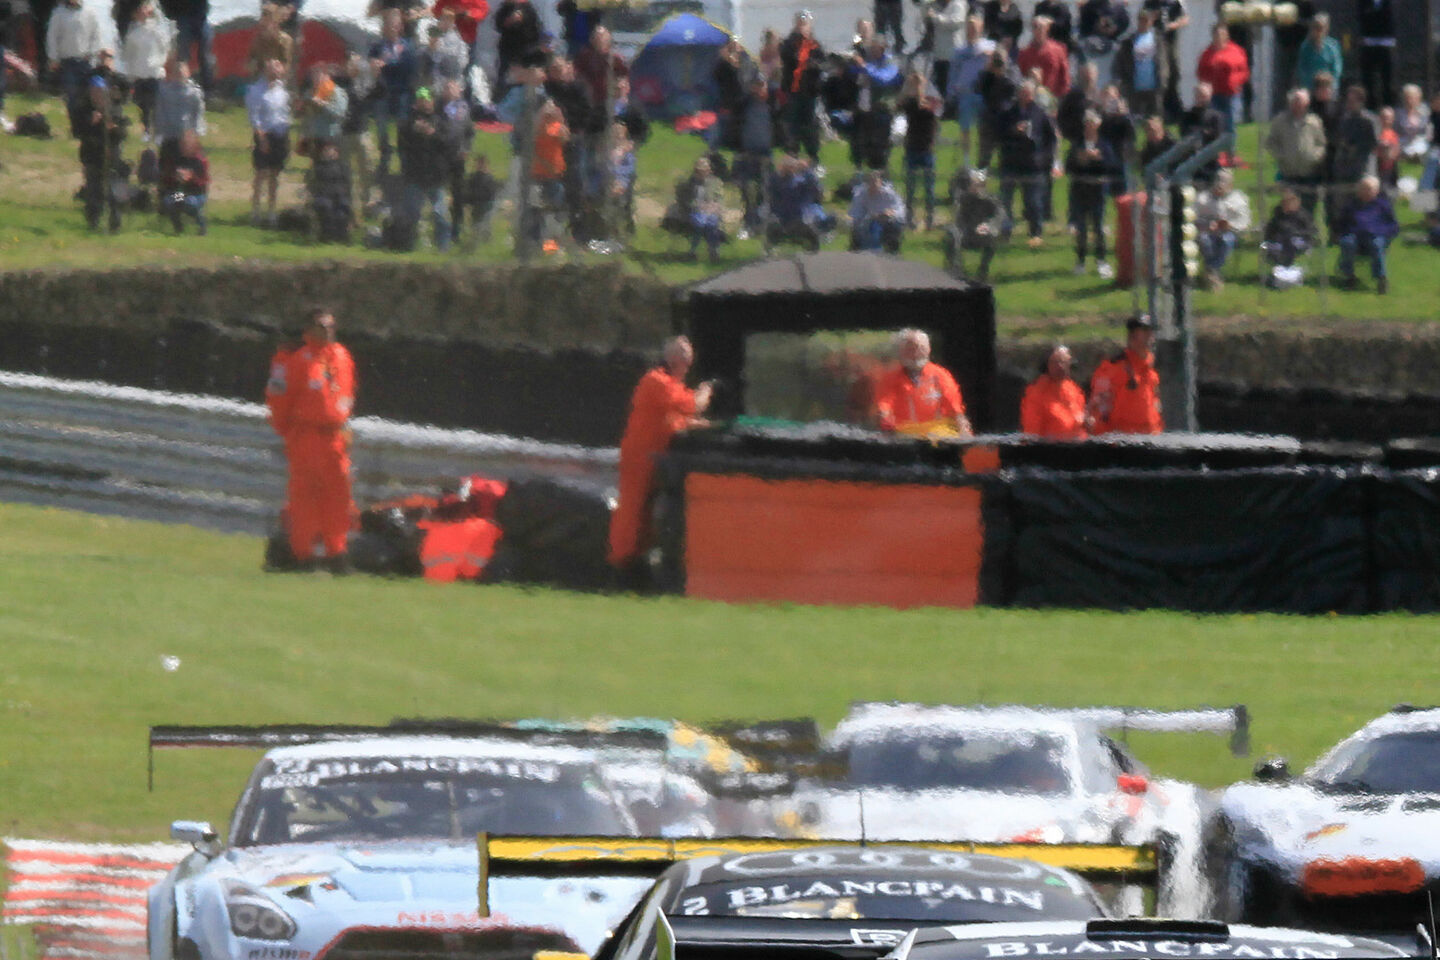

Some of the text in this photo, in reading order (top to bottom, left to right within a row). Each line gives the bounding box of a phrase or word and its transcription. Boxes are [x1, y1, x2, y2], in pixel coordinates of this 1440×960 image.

[683, 879, 1043, 915] 2 BLANCPAIN
[984, 940, 1339, 959] BLANCPAIN
